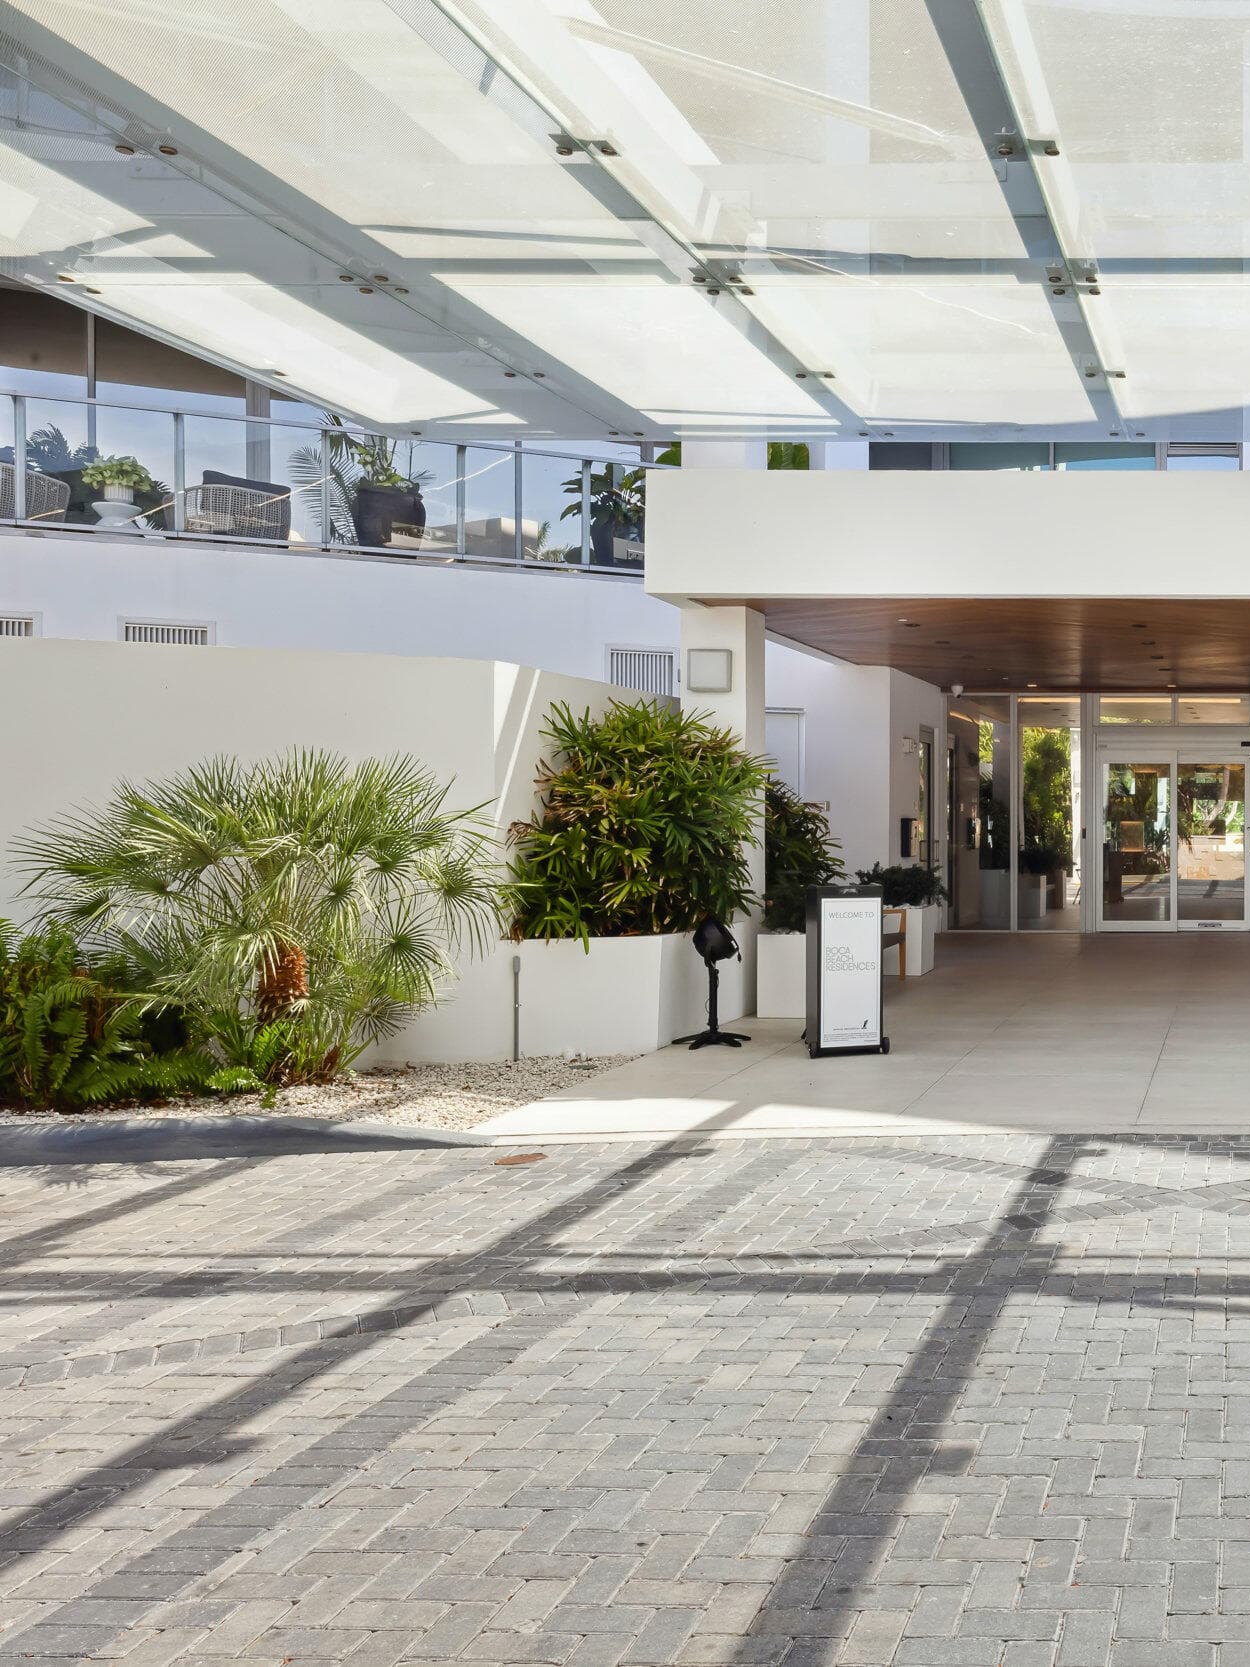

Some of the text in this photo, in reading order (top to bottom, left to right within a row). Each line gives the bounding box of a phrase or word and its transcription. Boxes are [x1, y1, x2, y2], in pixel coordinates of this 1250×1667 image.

[828, 911, 875, 919] WELCOME TO
[826, 946, 850, 954] BOCA
[826, 954, 854, 962] BEACH
[826, 962, 876, 971] RESIDENCES
